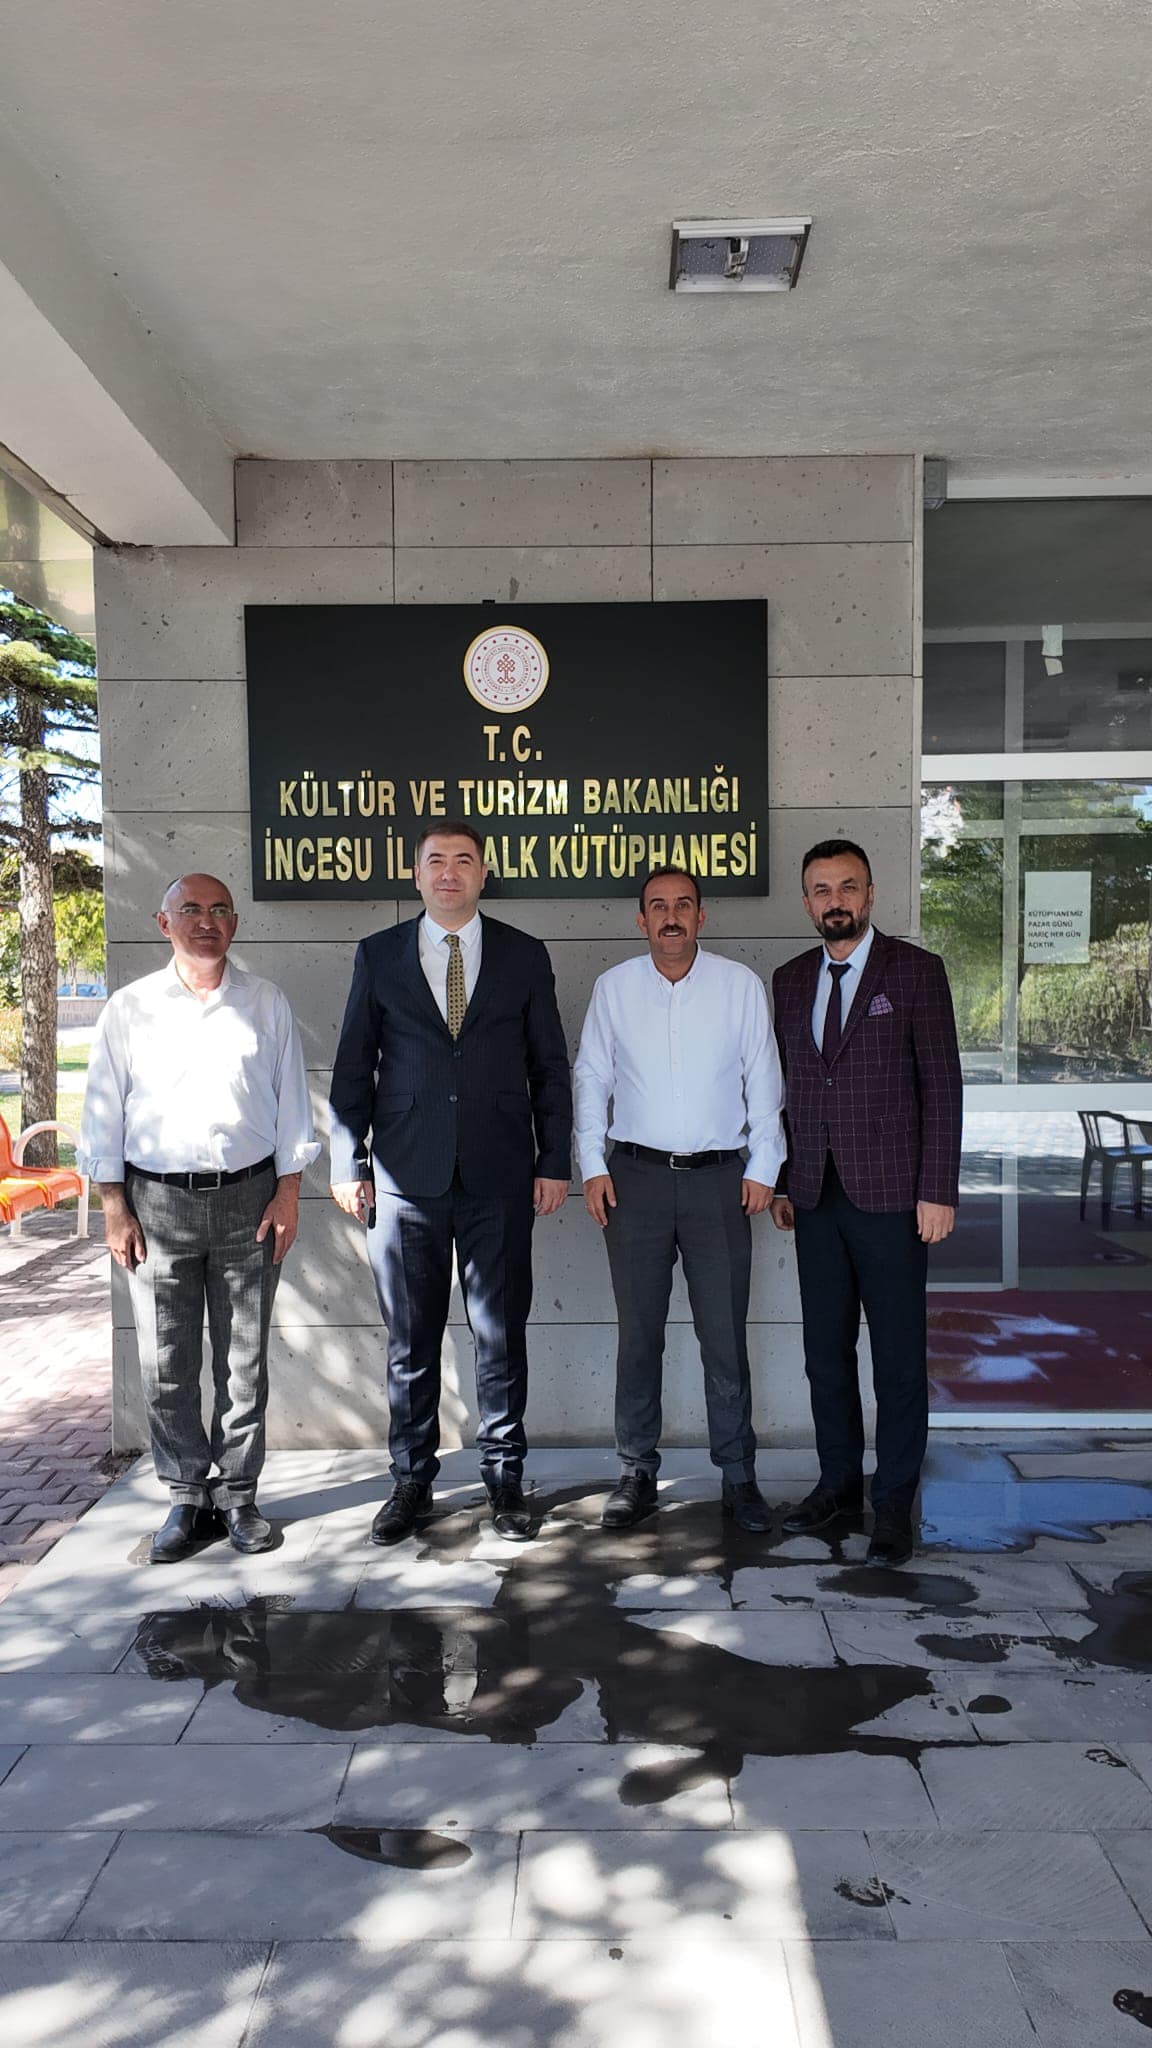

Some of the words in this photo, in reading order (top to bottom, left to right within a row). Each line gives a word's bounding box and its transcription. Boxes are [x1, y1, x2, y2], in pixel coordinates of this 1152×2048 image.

[279, 769, 397, 817] KÜLTÜR
[408, 780, 447, 816] VE
[458, 770, 569, 816] TURİZM
[583, 764, 739, 814] BAKANLIĞI
[264, 827, 373, 882] İNCESU
[385, 826, 418, 880] İL
[483, 835, 540, 879] ALK
[549, 821, 757, 879] KÜTÜPHANESİ
[1052, 920, 1073, 928] GÜNÜ
[1065, 930, 1081, 938] GÜN
